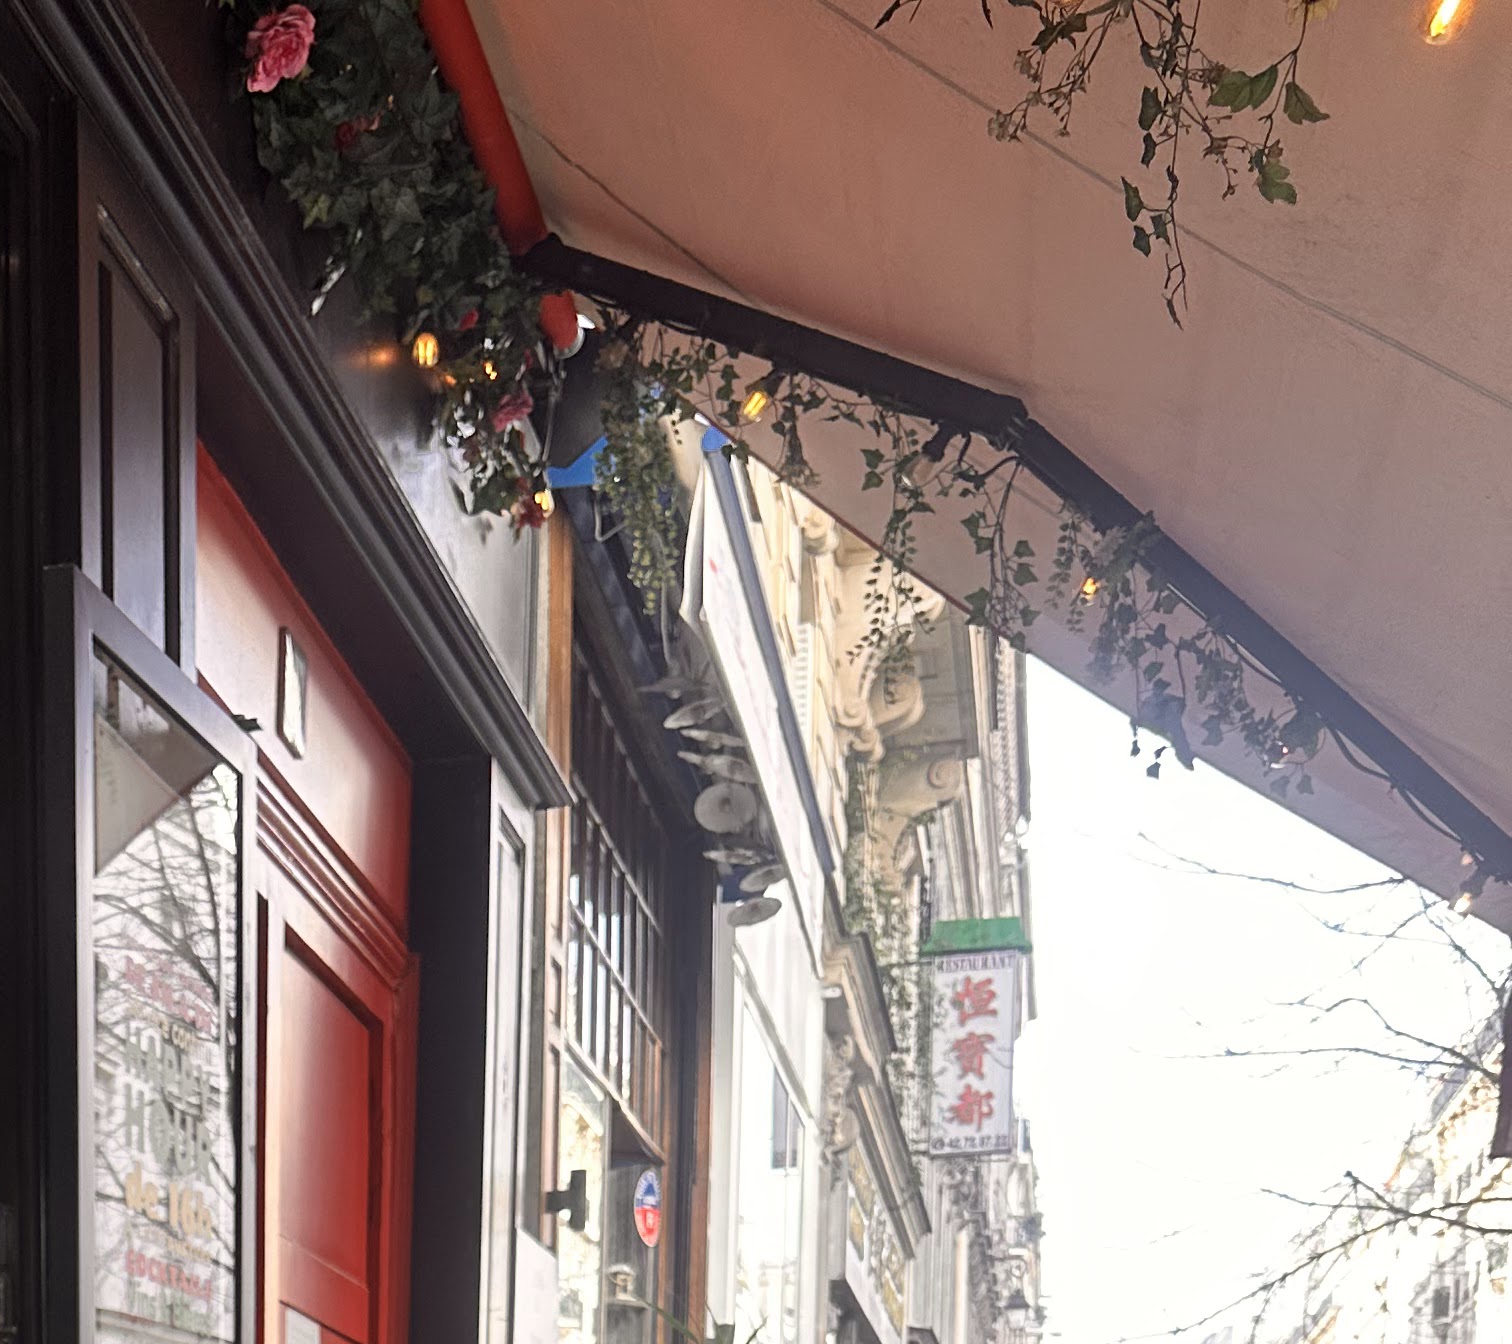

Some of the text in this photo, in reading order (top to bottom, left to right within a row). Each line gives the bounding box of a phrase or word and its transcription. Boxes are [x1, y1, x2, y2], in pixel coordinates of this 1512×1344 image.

[937, 953, 1015, 973] RESTAURANT
[124, 1082, 214, 1192] HOUR
[125, 1161, 159, 1222] de
